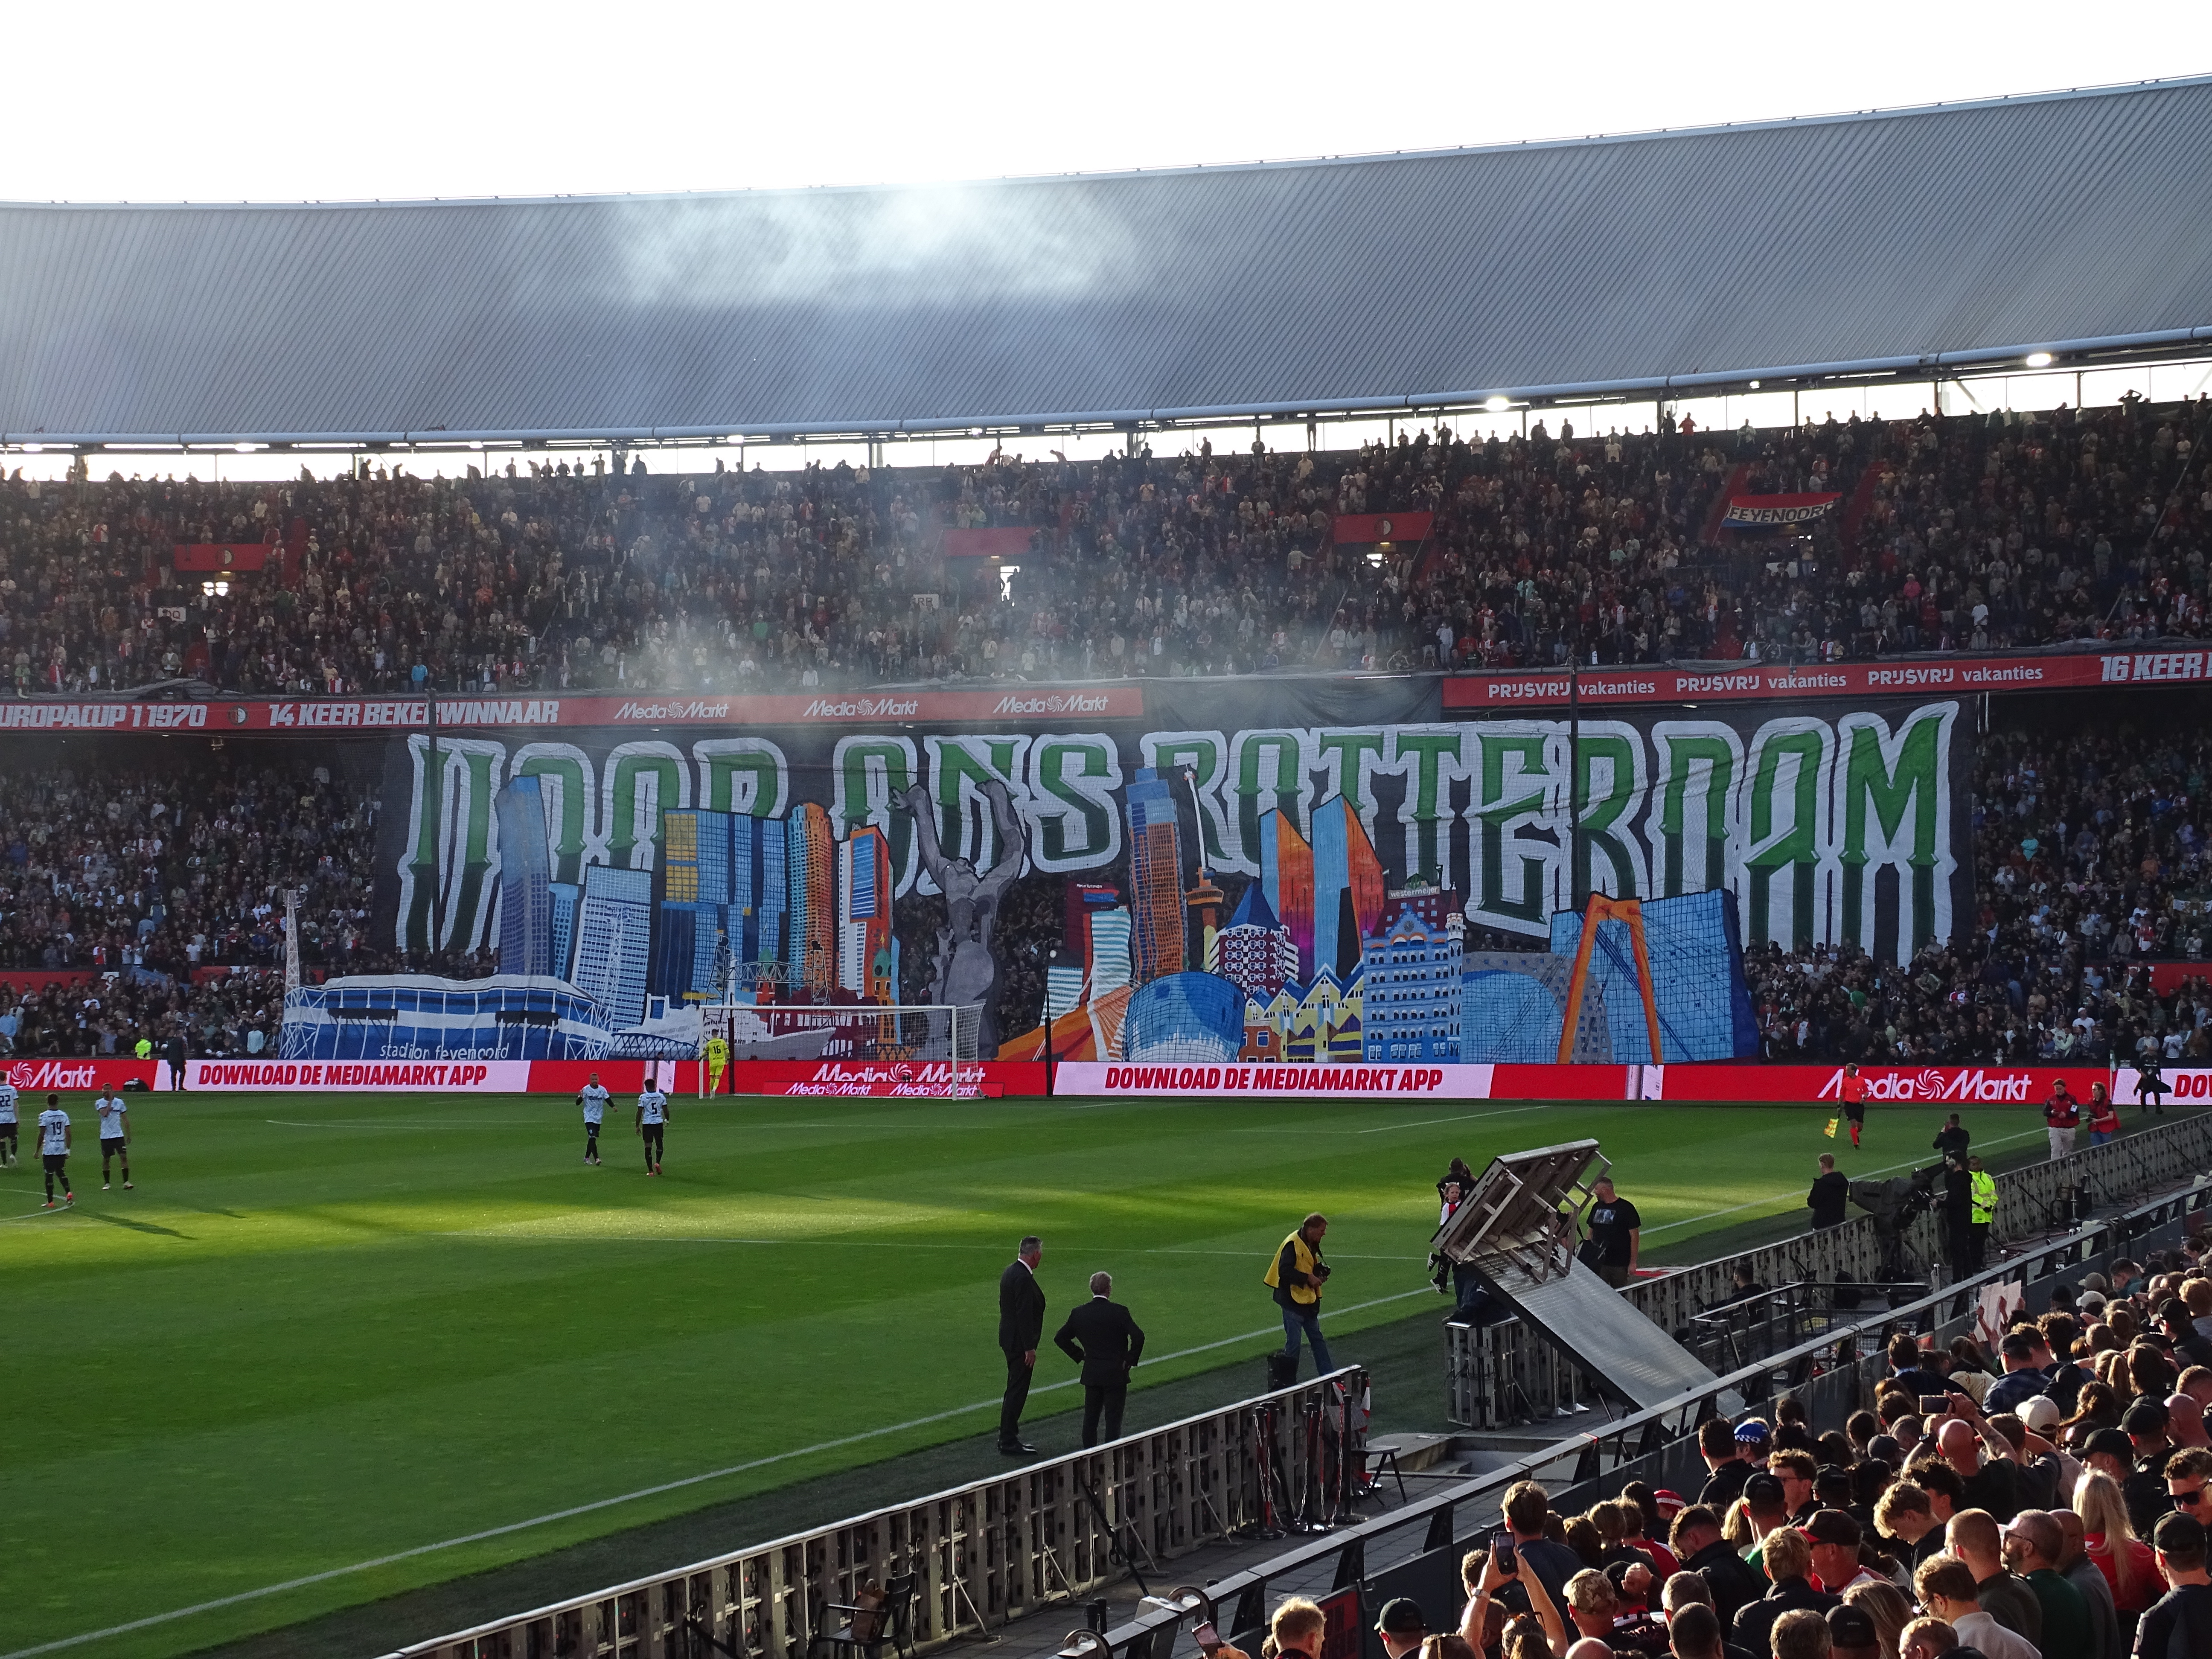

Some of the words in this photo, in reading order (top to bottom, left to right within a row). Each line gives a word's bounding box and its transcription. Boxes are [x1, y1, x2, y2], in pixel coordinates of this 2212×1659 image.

[1962, 666, 2043, 682] vakanties
[2100, 656, 2130, 681] 16
[2132, 653, 2202, 680] KEER
[1578, 680, 1656, 696] vakanties
[1768, 673, 1847, 689] vakanties
[614, 702, 667, 719] Media
[683, 701, 729, 718] Markt
[803, 700, 856, 717] Media
[870, 699, 918, 716] Markt
[993, 696, 1046, 713] Media
[1060, 695, 1108, 712] Markt
[147, 705, 207, 727] 1970
[269, 704, 295, 726] 14
[297, 703, 361, 726] KEER
[829, 733, 1123, 900] ONS
[1140, 700, 1959, 967] ROTTERDAM
[1391, 887, 1437, 897] westermeijer
[379, 1042, 430, 1060] stadion
[713, 1045, 721, 1054] 16
[29, 1062, 96, 1088] Markt
[198, 1065, 298, 1085] DOWNLOAD
[299, 1065, 322, 1085] DE
[324, 1065, 448, 1085] MEDIAMARKT
[448, 1065, 487, 1085] APP
[812, 1063, 888, 1082] Media
[1105, 1067, 1221, 1089] DOWNLOAD
[1223, 1068, 1251, 1089] DE
[1252, 1068, 1398, 1091] MEDIAMARKT
[1397, 1069, 1443, 1091] APP
[785, 1082, 825, 1095] Media
[834, 1082, 872, 1095] Markt
[889, 1083, 930, 1096] Media
[940, 1083, 977, 1096] Markt
[1941, 1069, 2032, 1100] Markt
[2174, 1074, 2212, 1098] DO
[651, 1102, 658, 1115] 5
[51, 1121, 62, 1135] 19
